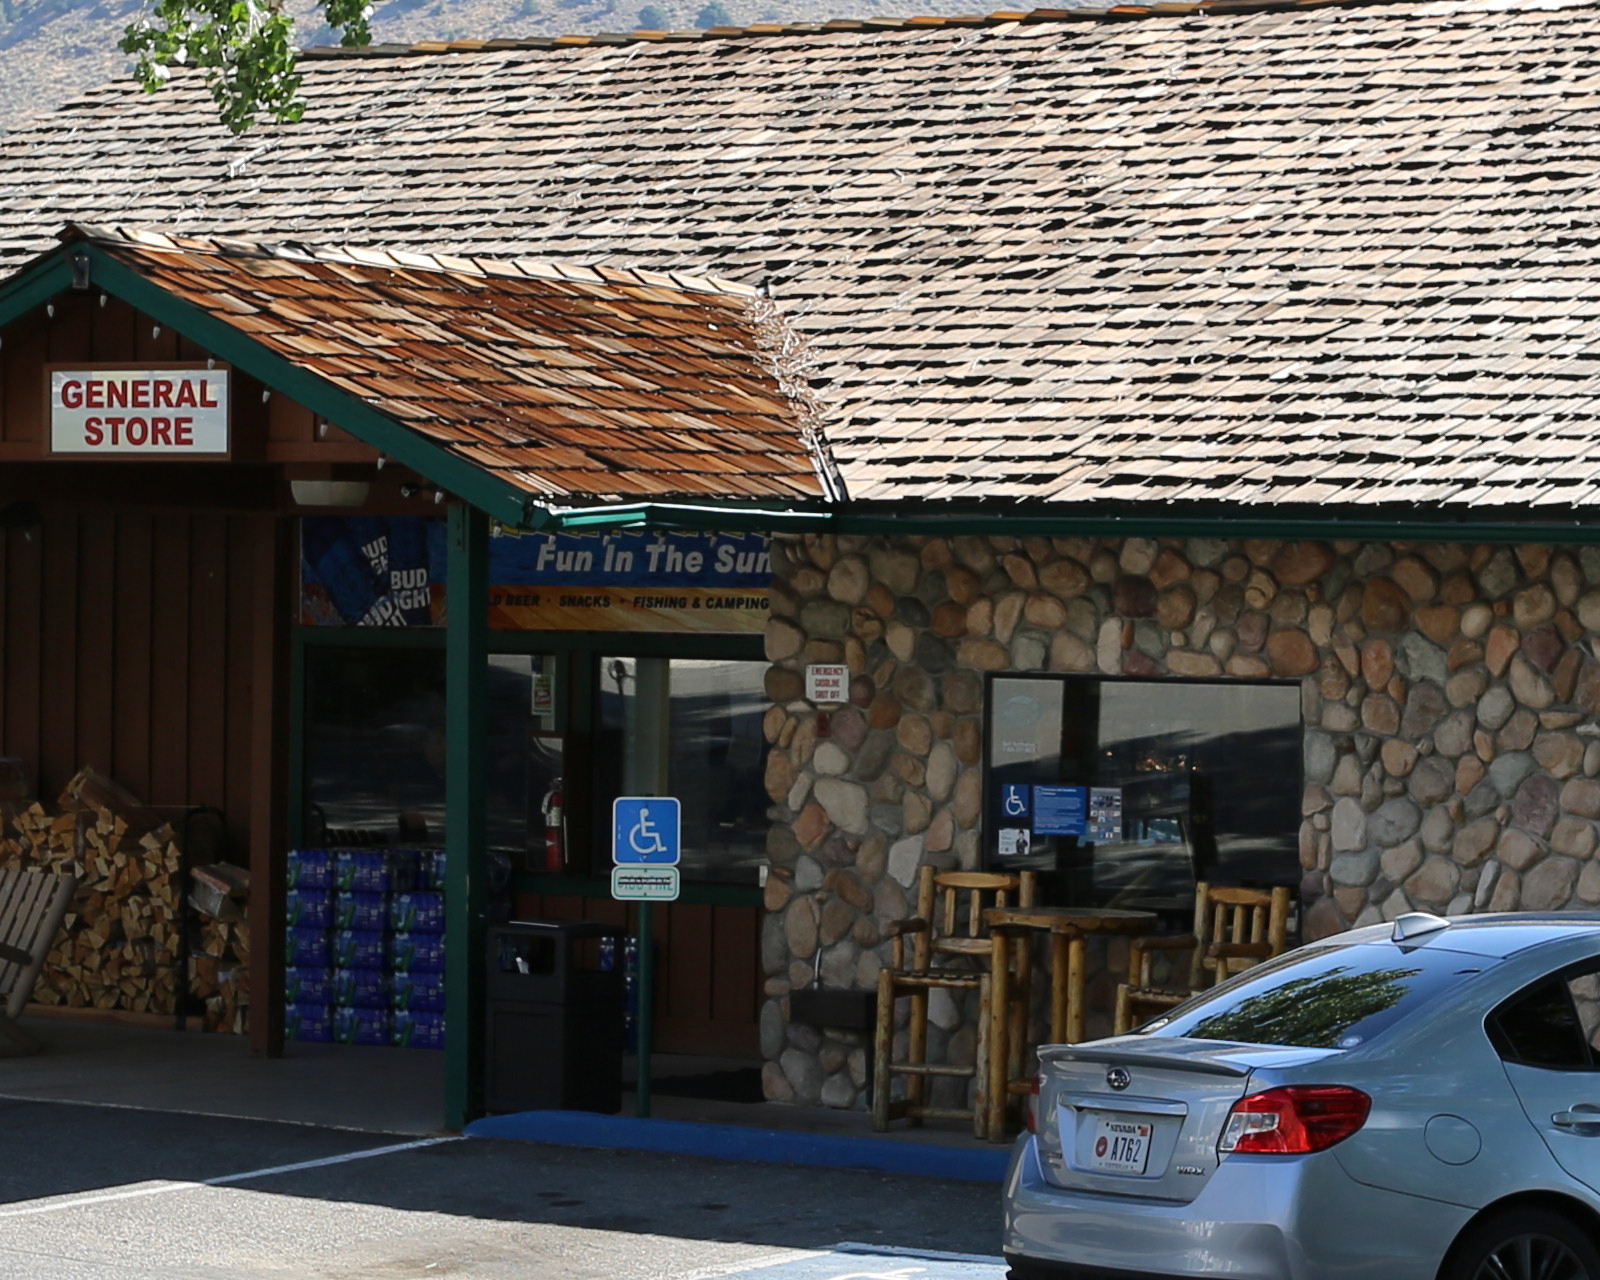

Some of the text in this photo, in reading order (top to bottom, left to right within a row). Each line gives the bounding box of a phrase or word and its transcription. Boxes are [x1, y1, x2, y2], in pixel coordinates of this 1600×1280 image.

[61, 380, 218, 409] GENERAL
[84, 417, 193, 446] STORE
[537, 544, 773, 573] Fun In The Sun
[390, 568, 428, 590] BUD
[506, 595, 540, 607] BEER
[559, 595, 611, 608] SNACKS
[633, 596, 687, 609] FISHING
[692, 597, 700, 609] &
[705, 597, 769, 610] CAMPING
[1111, 1136, 1142, 1163] A762
